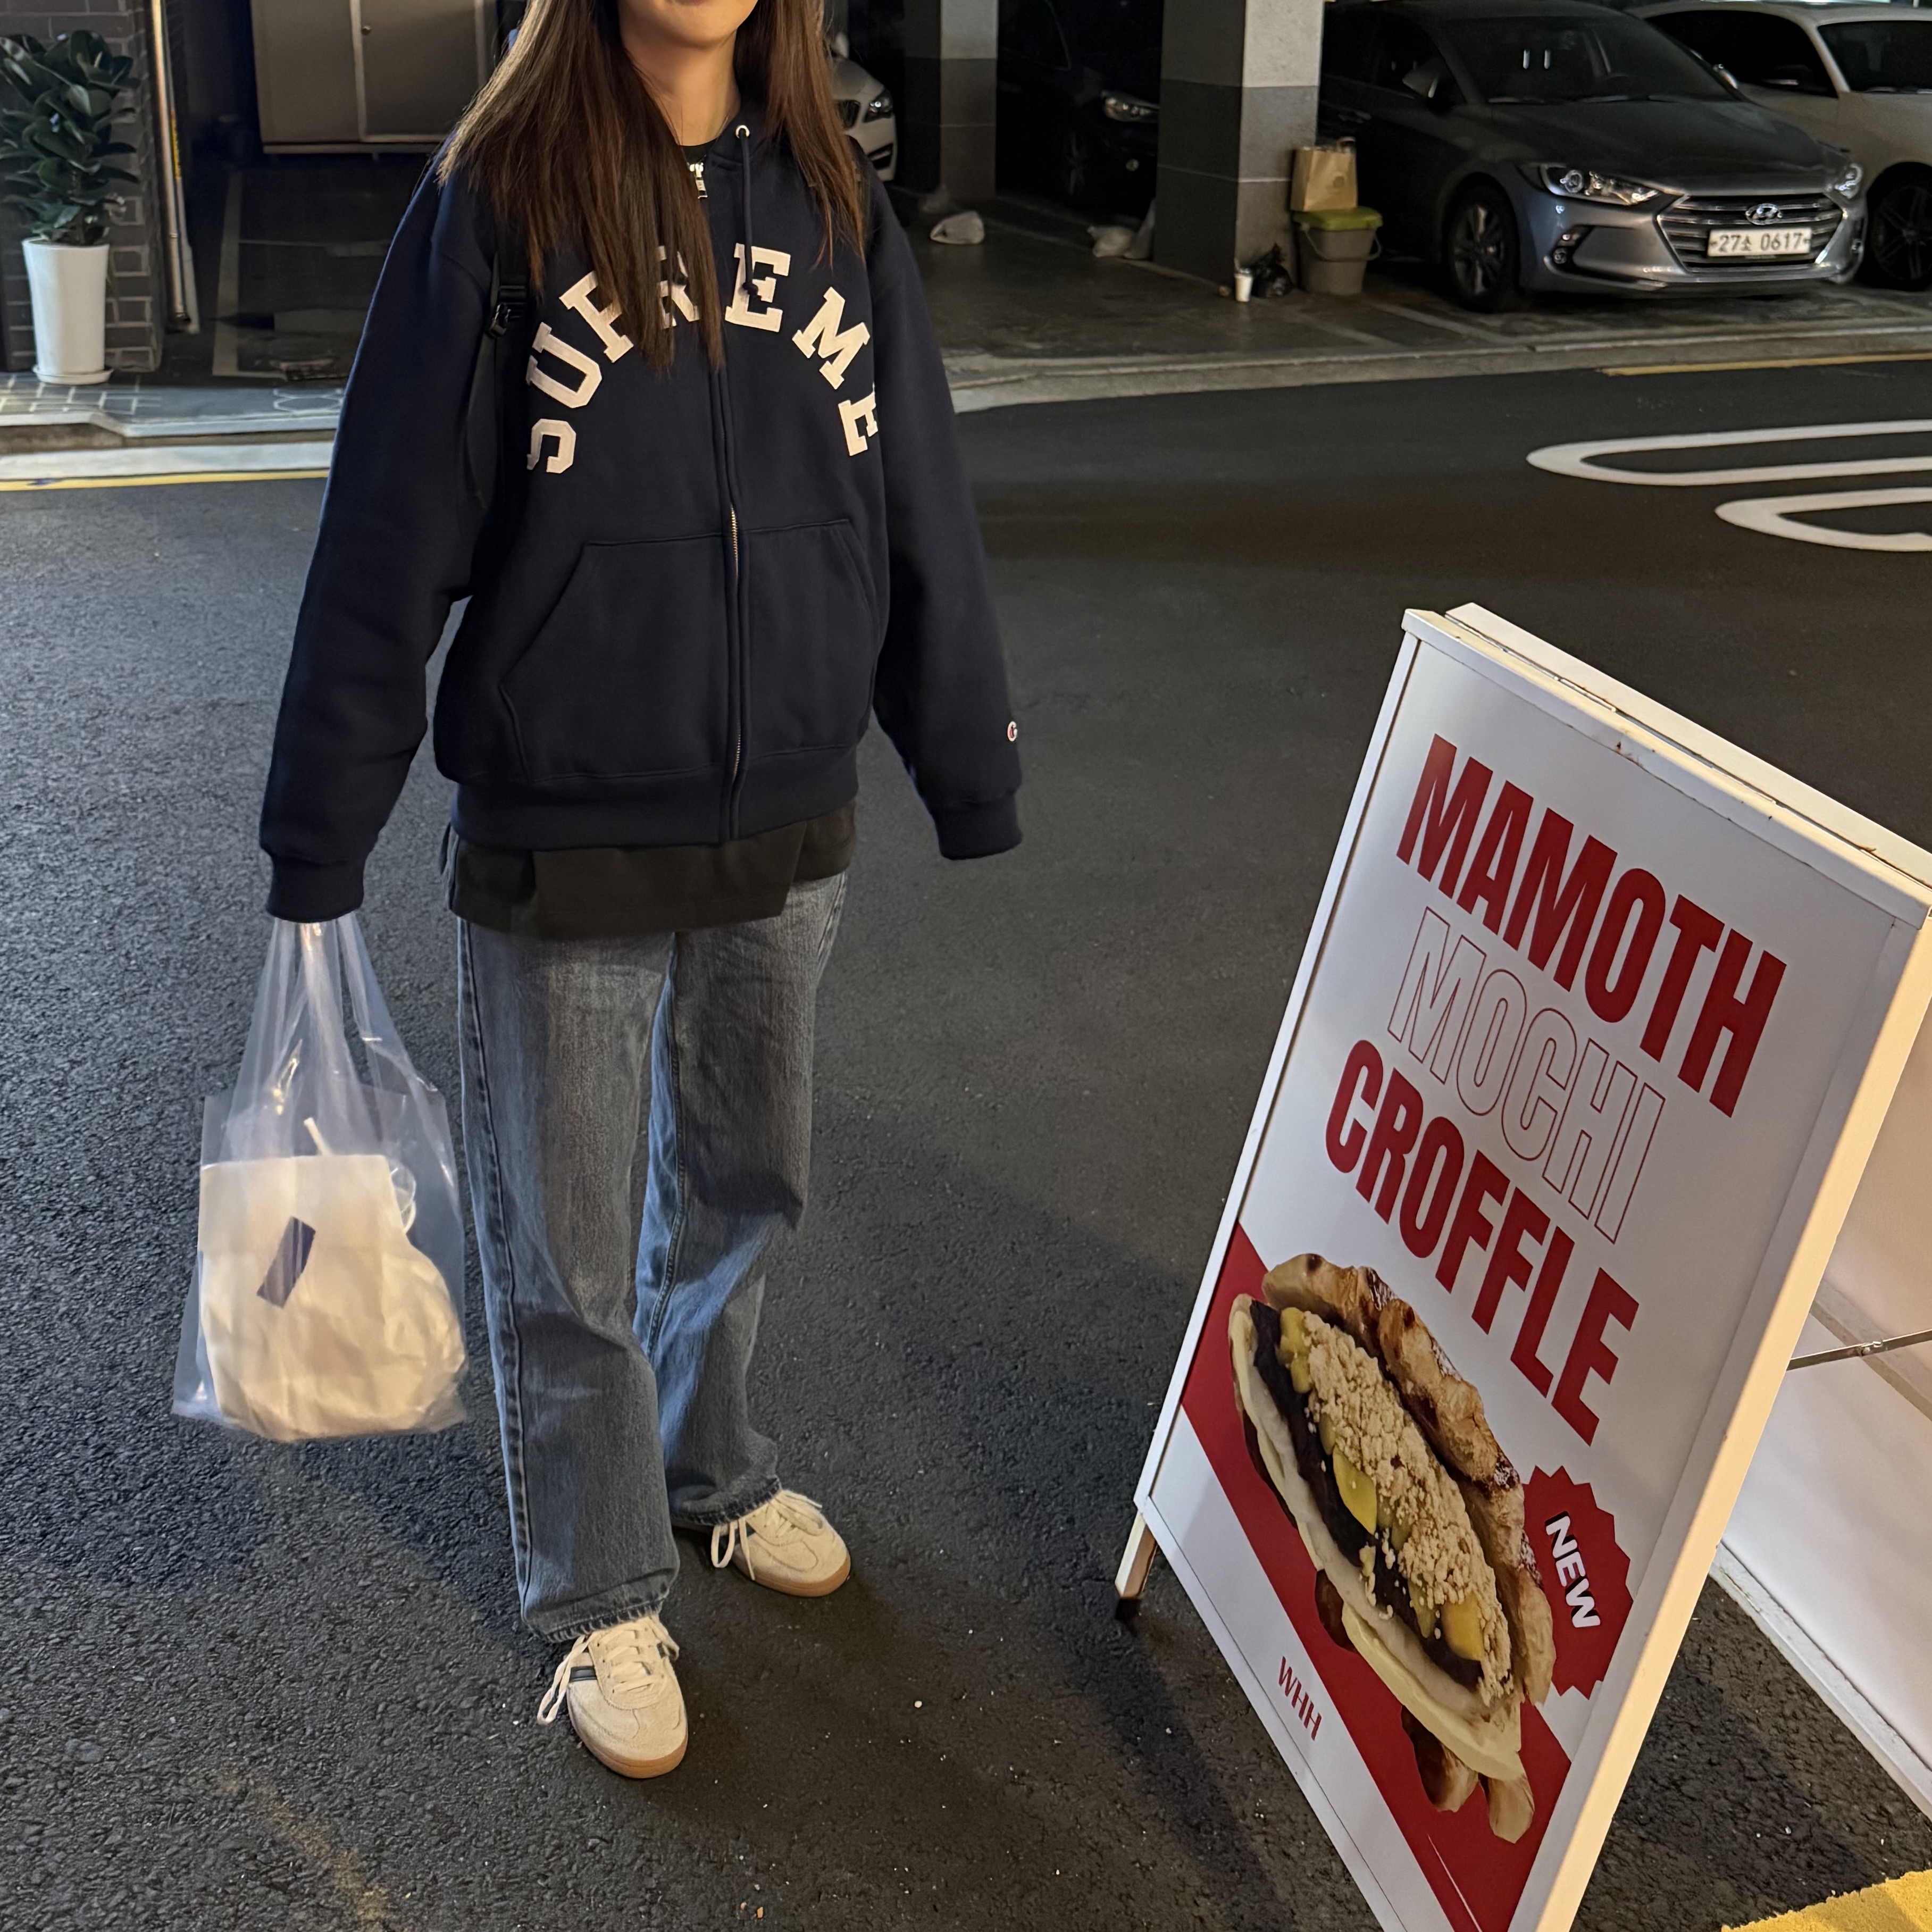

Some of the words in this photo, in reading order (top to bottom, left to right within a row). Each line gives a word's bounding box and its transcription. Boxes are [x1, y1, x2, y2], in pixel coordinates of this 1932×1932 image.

[1761, 232, 1802, 251] 0617
[1396, 733, 1787, 1118] MAMOTH
[1387, 906, 1666, 1244] MOCHI
[1326, 1040, 1640, 1446] CROFFLE
[1545, 1513, 1601, 1628] NEW
[1278, 1655, 1322, 1741] WHH
